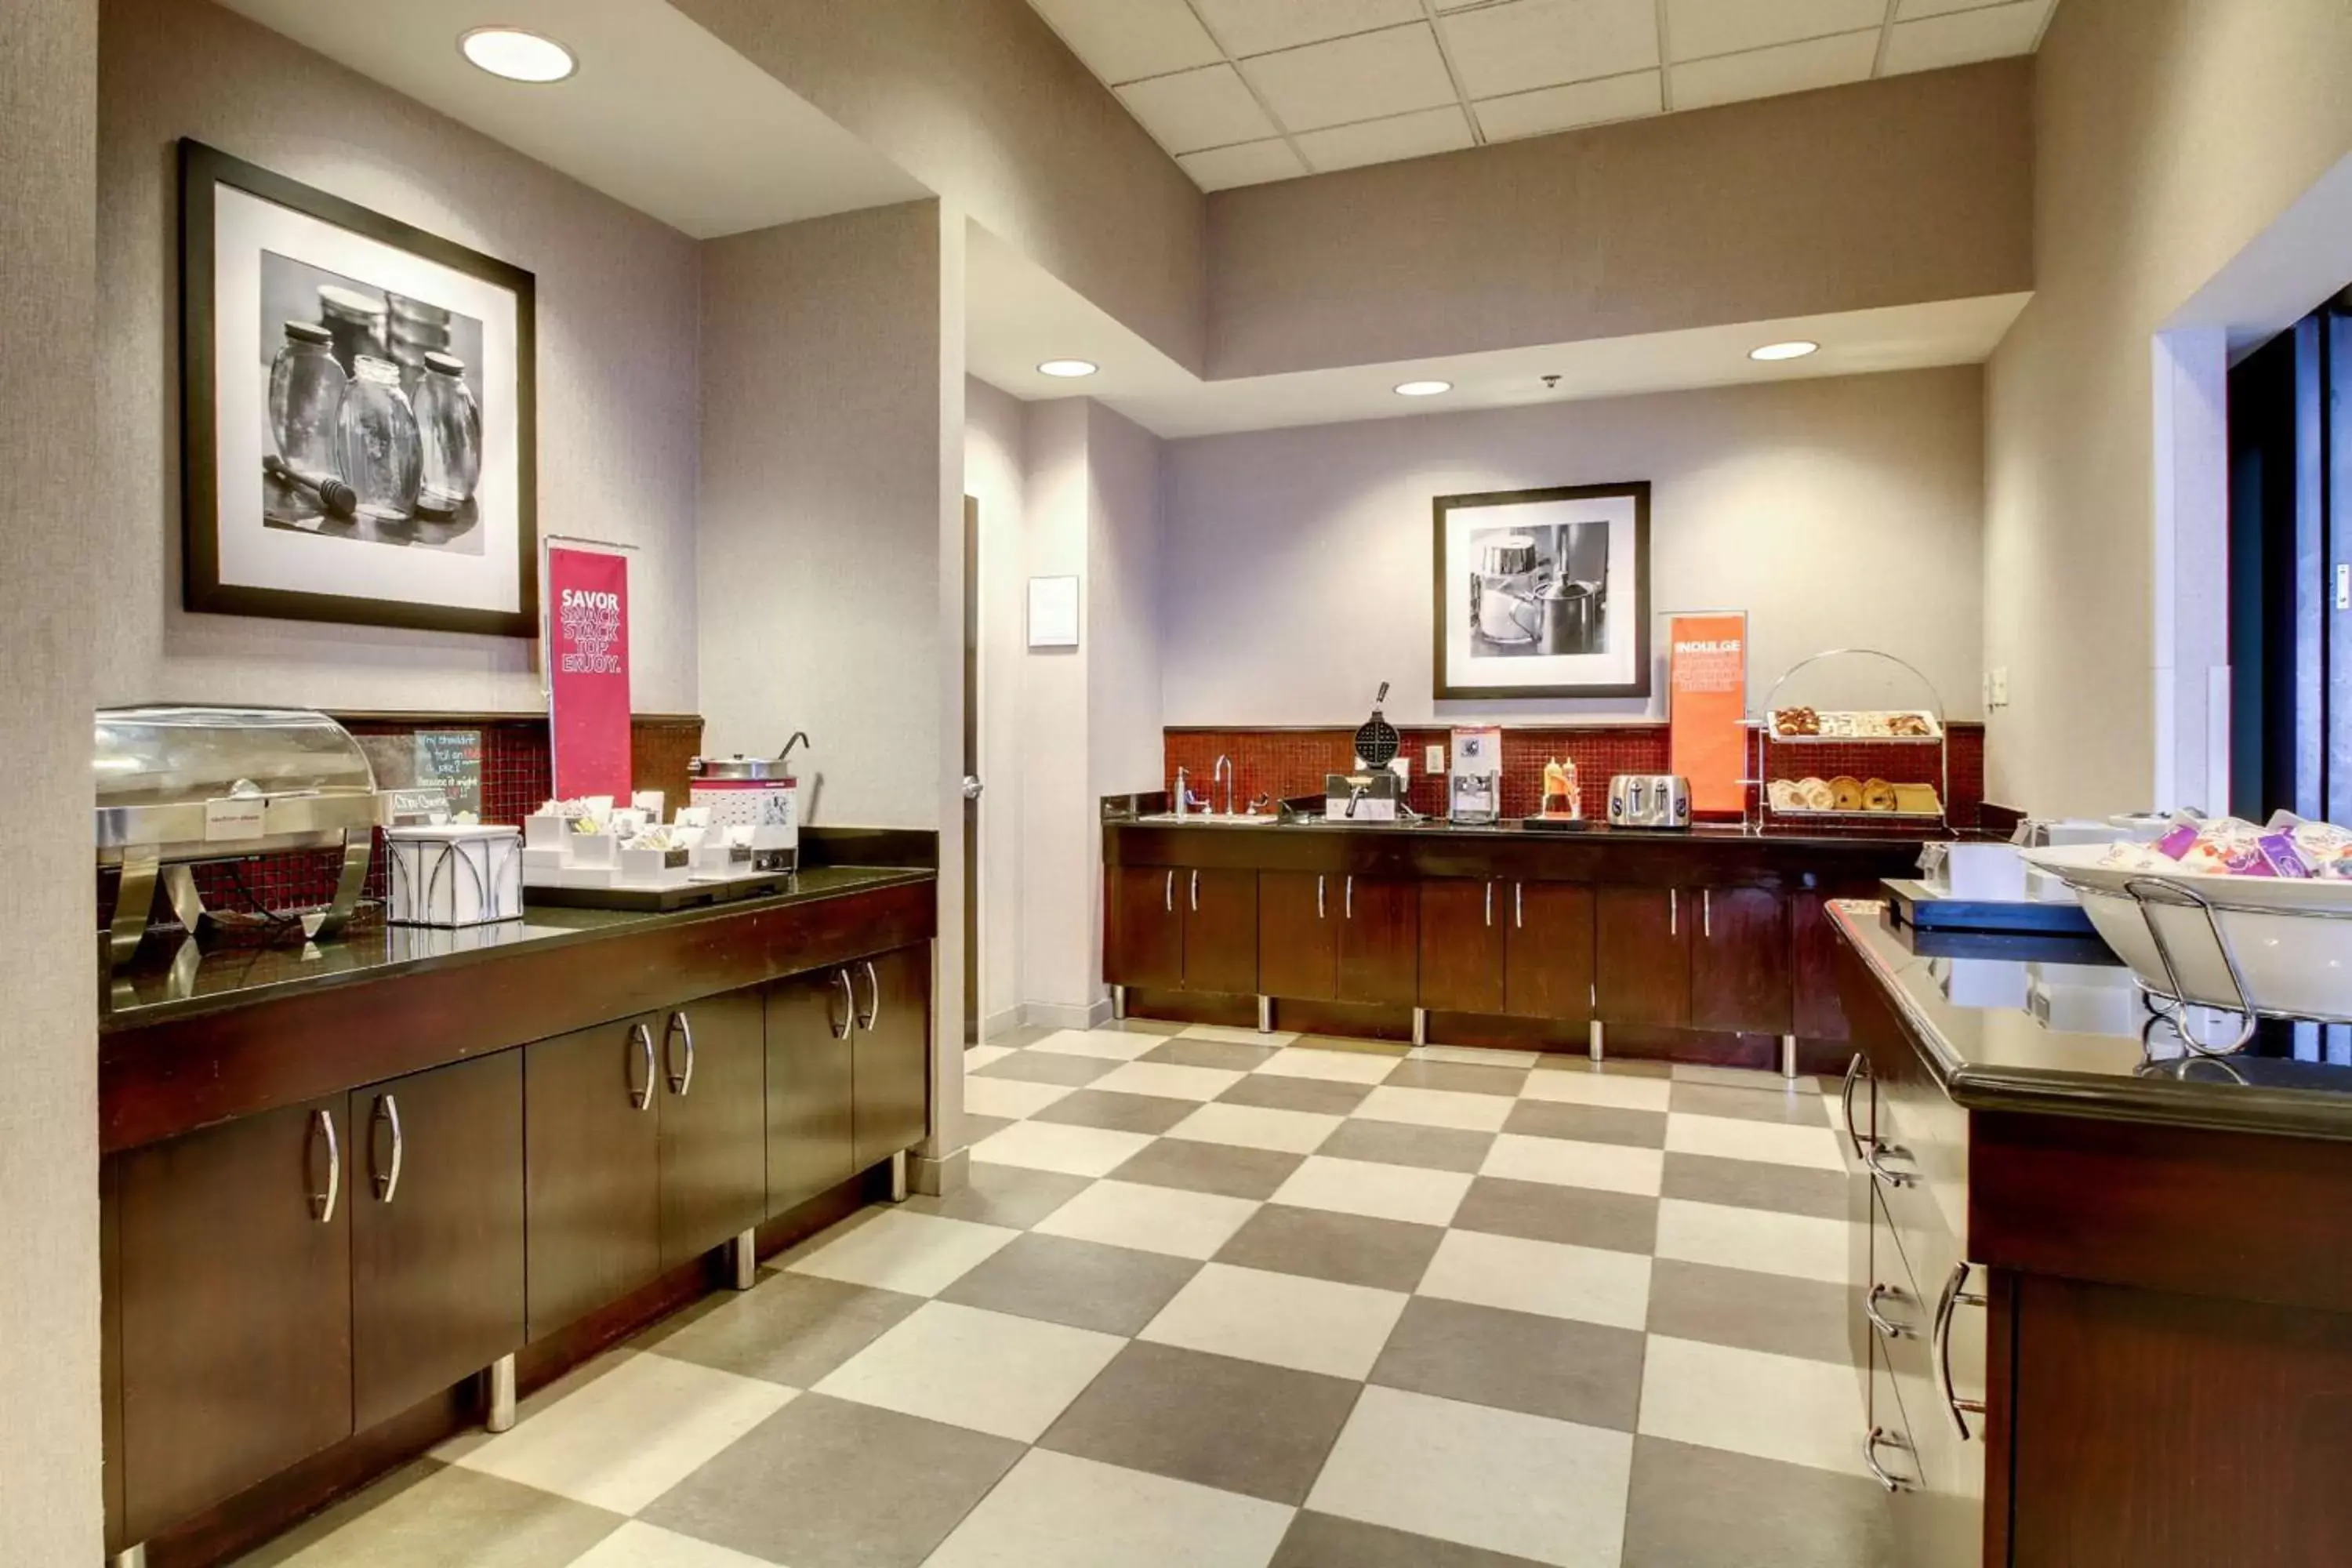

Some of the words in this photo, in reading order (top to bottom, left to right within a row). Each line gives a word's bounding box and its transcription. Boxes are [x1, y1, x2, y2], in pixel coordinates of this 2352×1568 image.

[562, 589, 619, 609] SAVOR
[563, 621, 620, 641] STACK
[575, 637, 609, 654] TOP
[1674, 640, 1741, 652] INDULGE
[562, 652, 621, 673] ENJOY.
